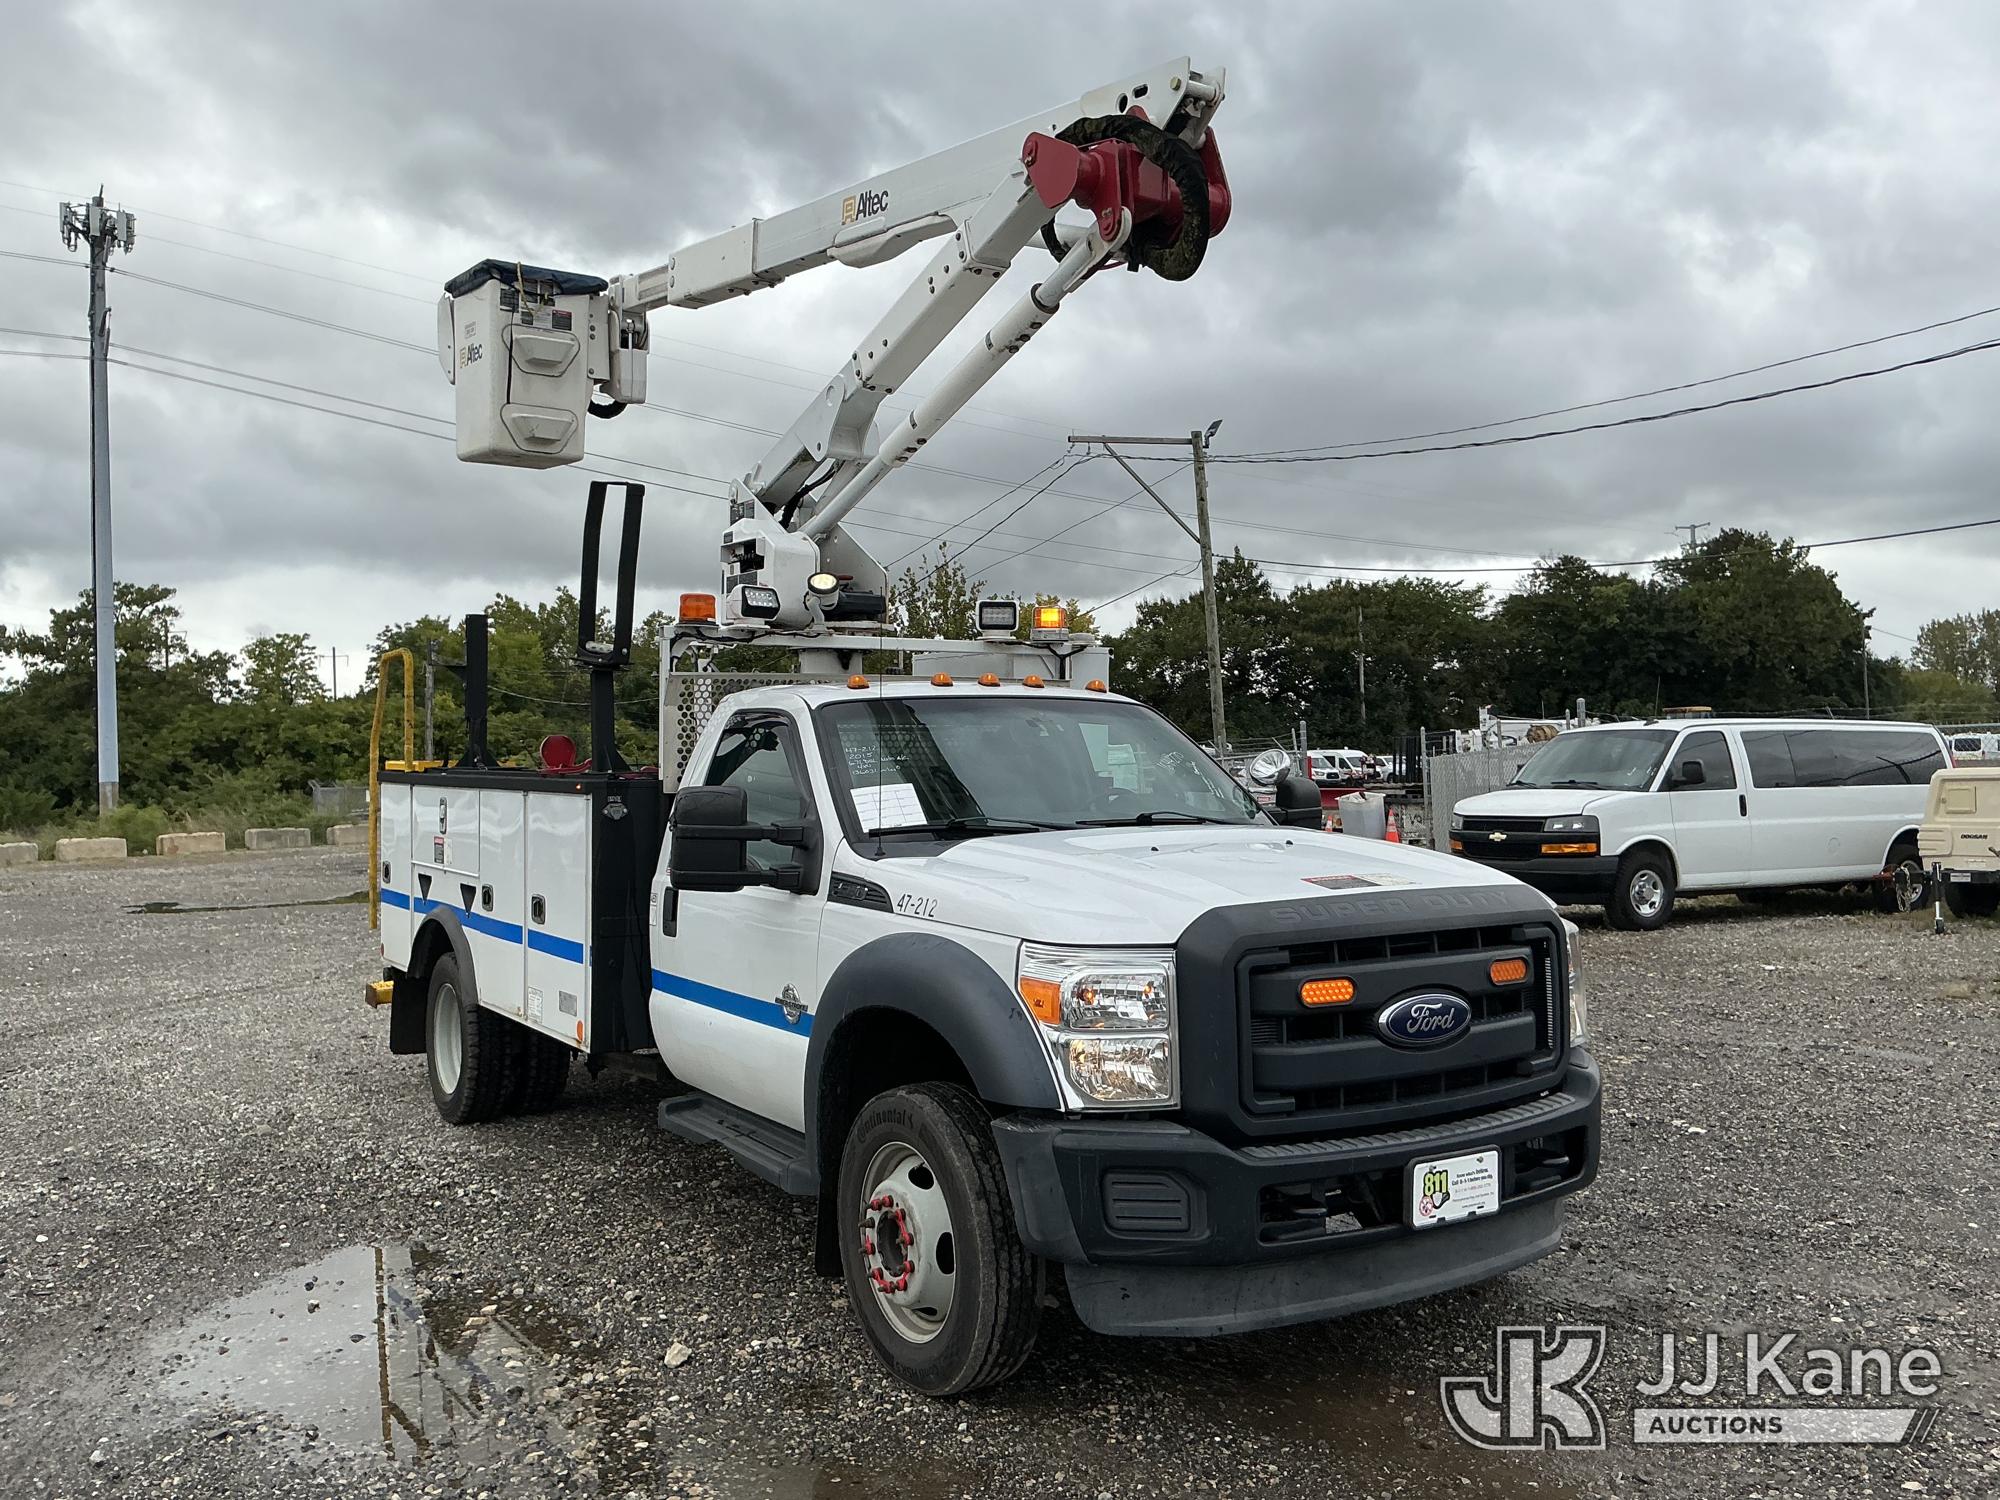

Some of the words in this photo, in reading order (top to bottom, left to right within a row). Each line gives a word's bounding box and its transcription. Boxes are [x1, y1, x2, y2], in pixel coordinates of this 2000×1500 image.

[856, 190, 888, 220] Altec
[466, 343, 482, 366] Altec
[897, 893, 938, 918] 47-212
[1270, 897, 1411, 923] SUPER
[1424, 890, 1509, 912] DUTY
[1406, 1003, 1455, 1034] Ford
[857, 1108, 907, 1144] Continental
[1423, 1170, 1448, 1196] 811
